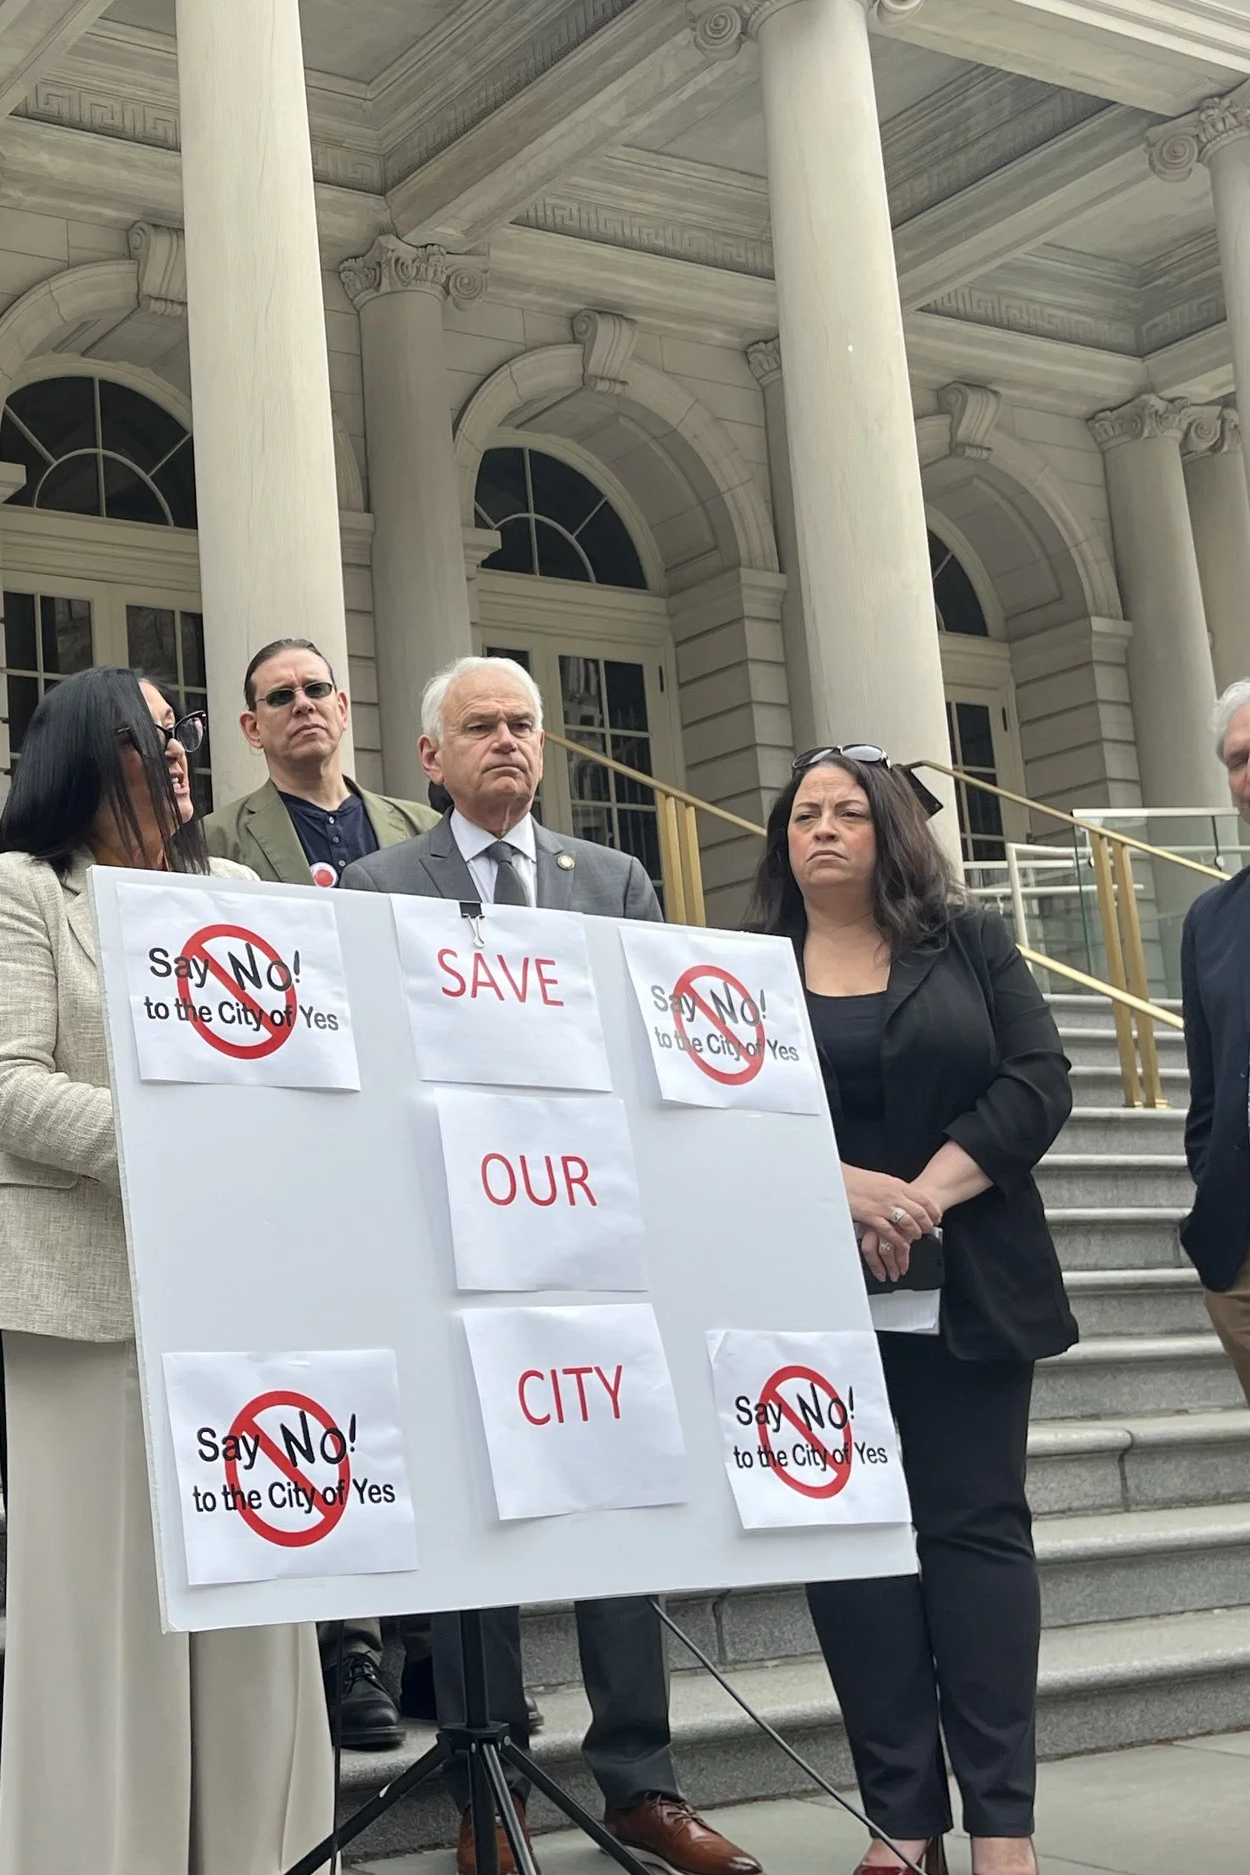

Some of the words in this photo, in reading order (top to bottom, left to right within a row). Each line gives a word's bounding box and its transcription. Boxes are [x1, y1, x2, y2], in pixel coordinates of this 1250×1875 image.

[148, 946, 209, 989] Say
[228, 942, 302, 993] No!
[436, 947, 565, 1008] SAVE
[144, 996, 170, 1020] to
[174, 997, 213, 1024] the
[217, 1000, 264, 1032] City
[268, 1003, 295, 1028] of
[298, 1004, 339, 1031] Yes
[651, 985, 696, 1022] Say
[709, 981, 767, 1028] No!
[655, 1026, 673, 1049] to
[706, 1033, 743, 1063] City
[745, 1036, 764, 1058] of
[766, 1039, 800, 1062] Yes
[480, 1152, 598, 1207] OUR
[517, 1364, 623, 1426] CITY
[735, 1394, 783, 1433] Say
[796, 1383, 855, 1432] No!
[196, 1427, 261, 1470] Say
[279, 1410, 357, 1467] No!
[733, 1445, 754, 1469] to
[757, 1443, 788, 1467] the
[792, 1442, 829, 1472] City
[831, 1442, 852, 1466] of
[854, 1441, 888, 1465] Yes
[193, 1485, 217, 1512] to
[221, 1483, 262, 1510] the
[268, 1480, 317, 1514] City
[321, 1479, 346, 1506] of
[352, 1478, 396, 1505] Yes
